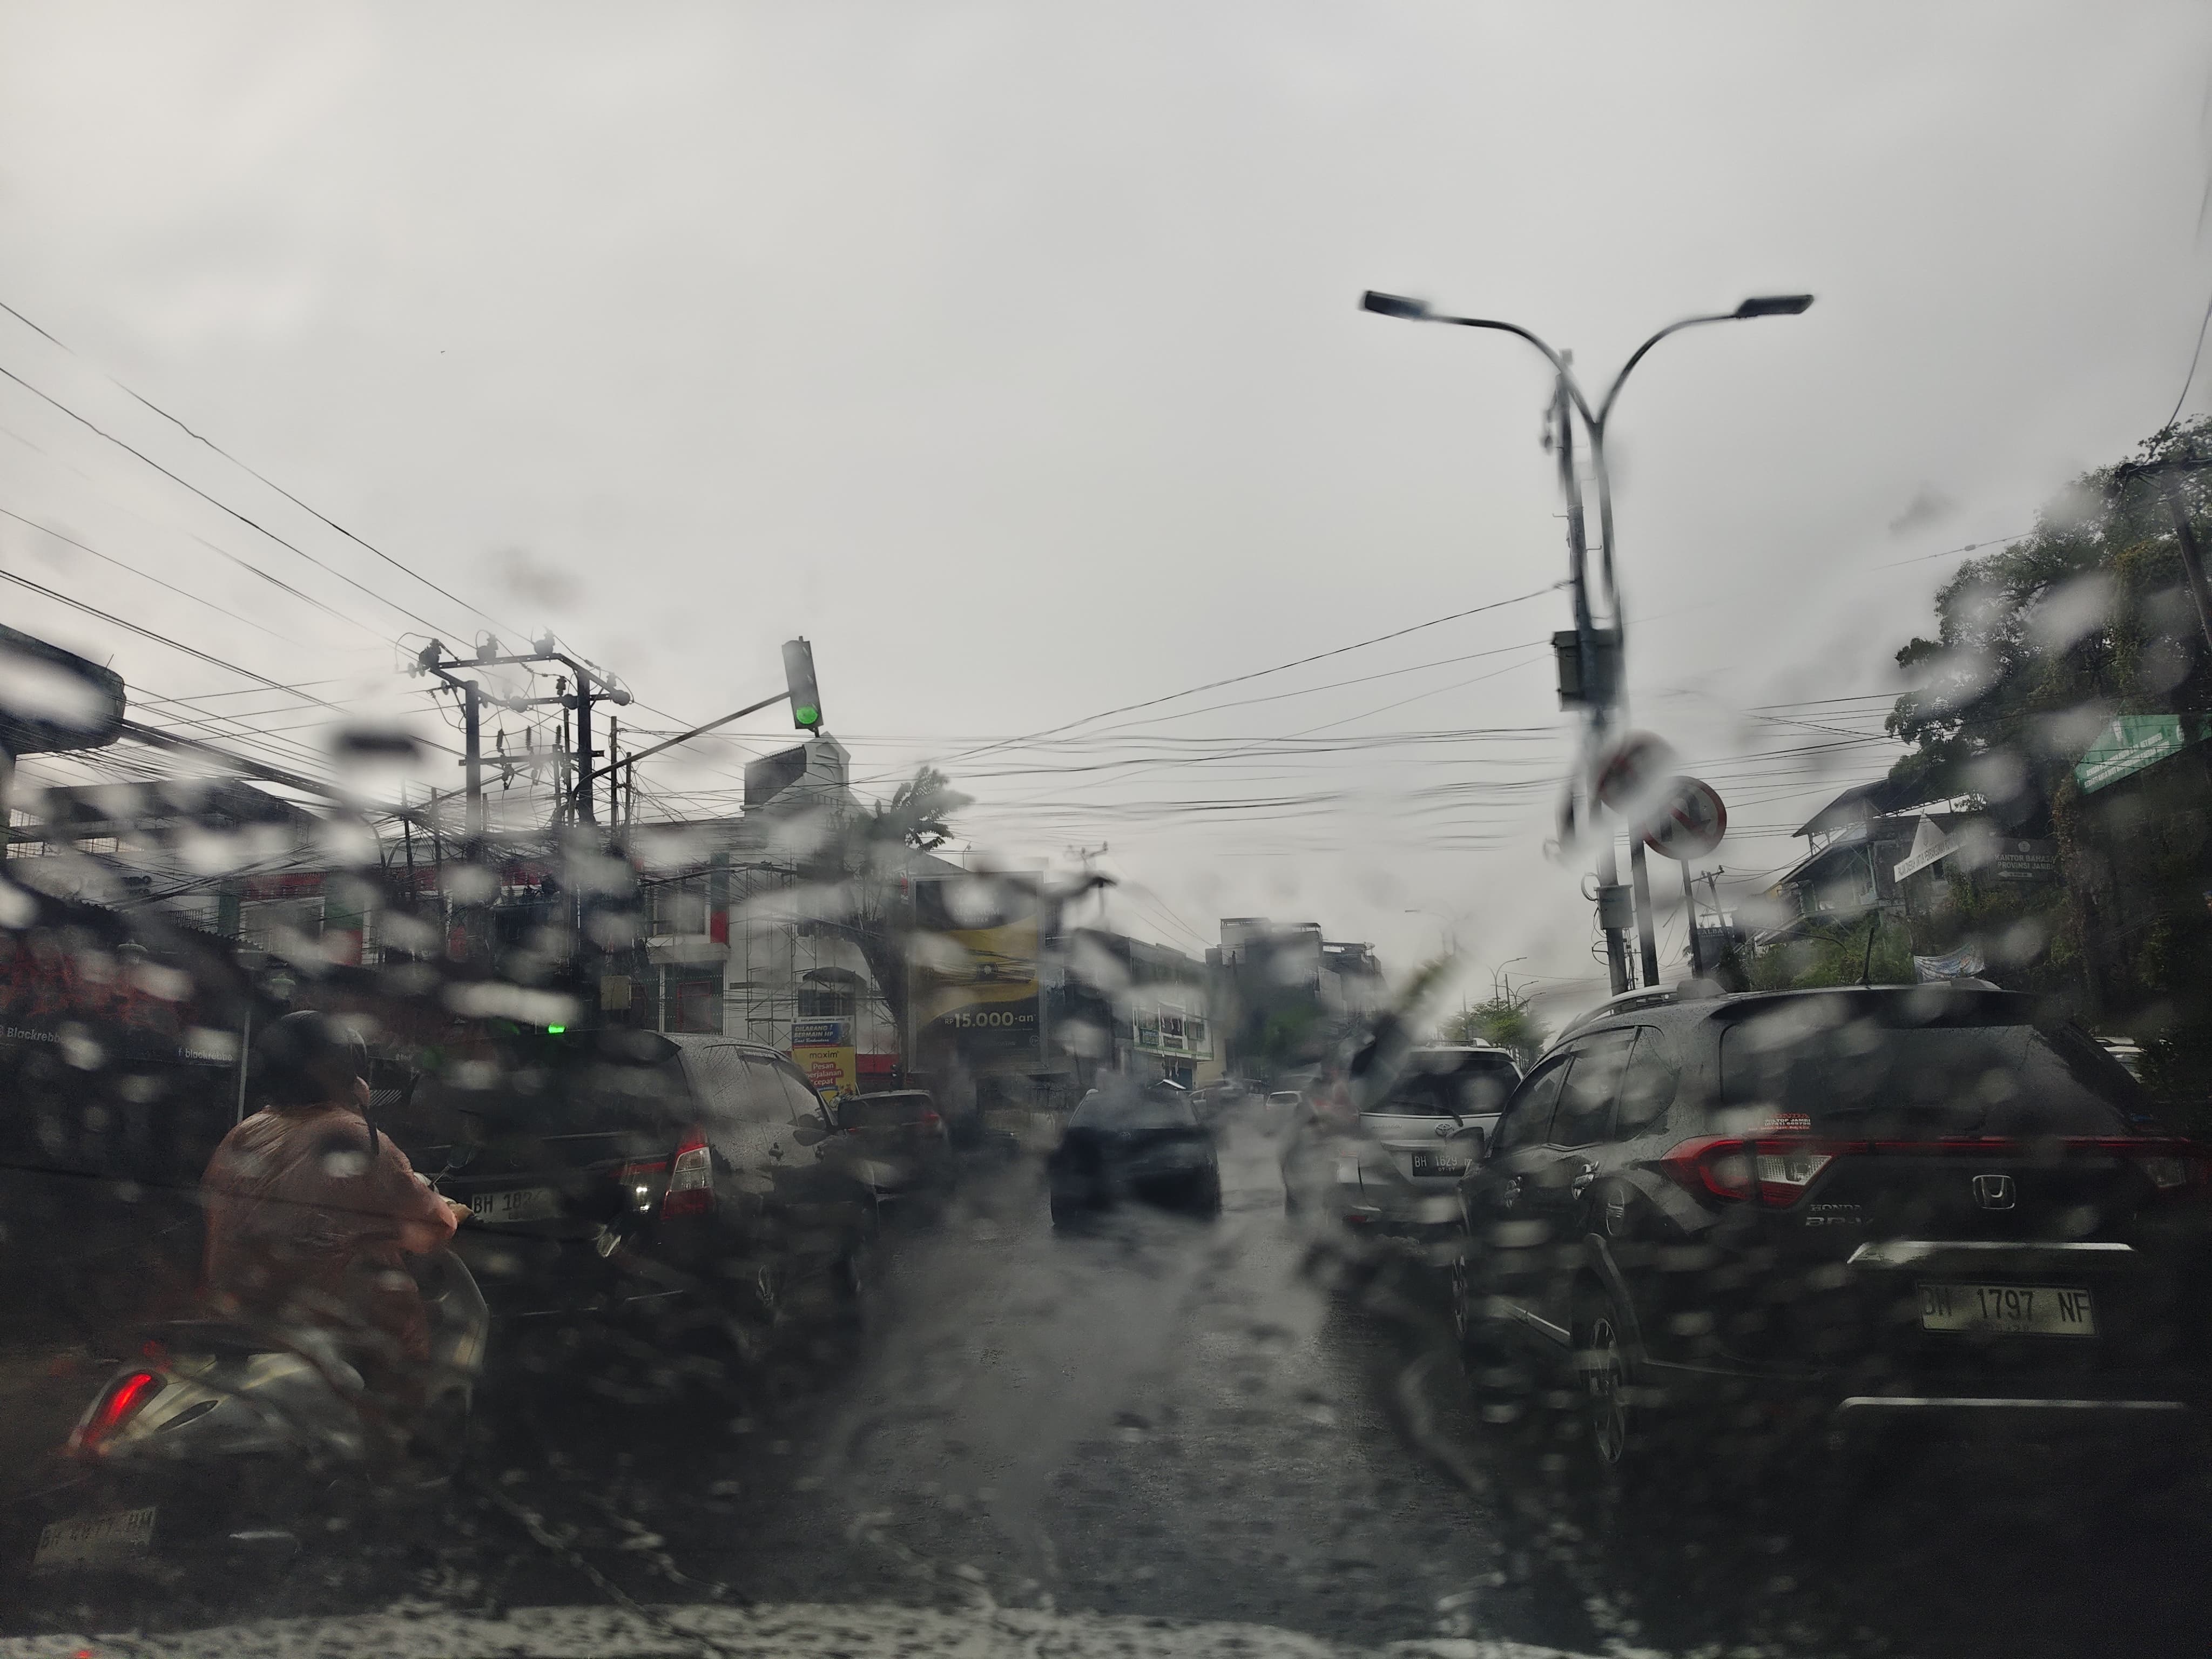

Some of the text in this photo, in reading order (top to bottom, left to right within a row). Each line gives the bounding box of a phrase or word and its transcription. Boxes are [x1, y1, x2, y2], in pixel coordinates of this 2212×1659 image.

[814, 1078, 833, 1086] cepat
[1415, 1156, 1427, 1167] BH
[1435, 1156, 1457, 1166] 1629
[474, 1195, 493, 1213] BH
[1977, 1288, 2034, 1321] 1797
[2058, 1291, 2090, 1323] NF
